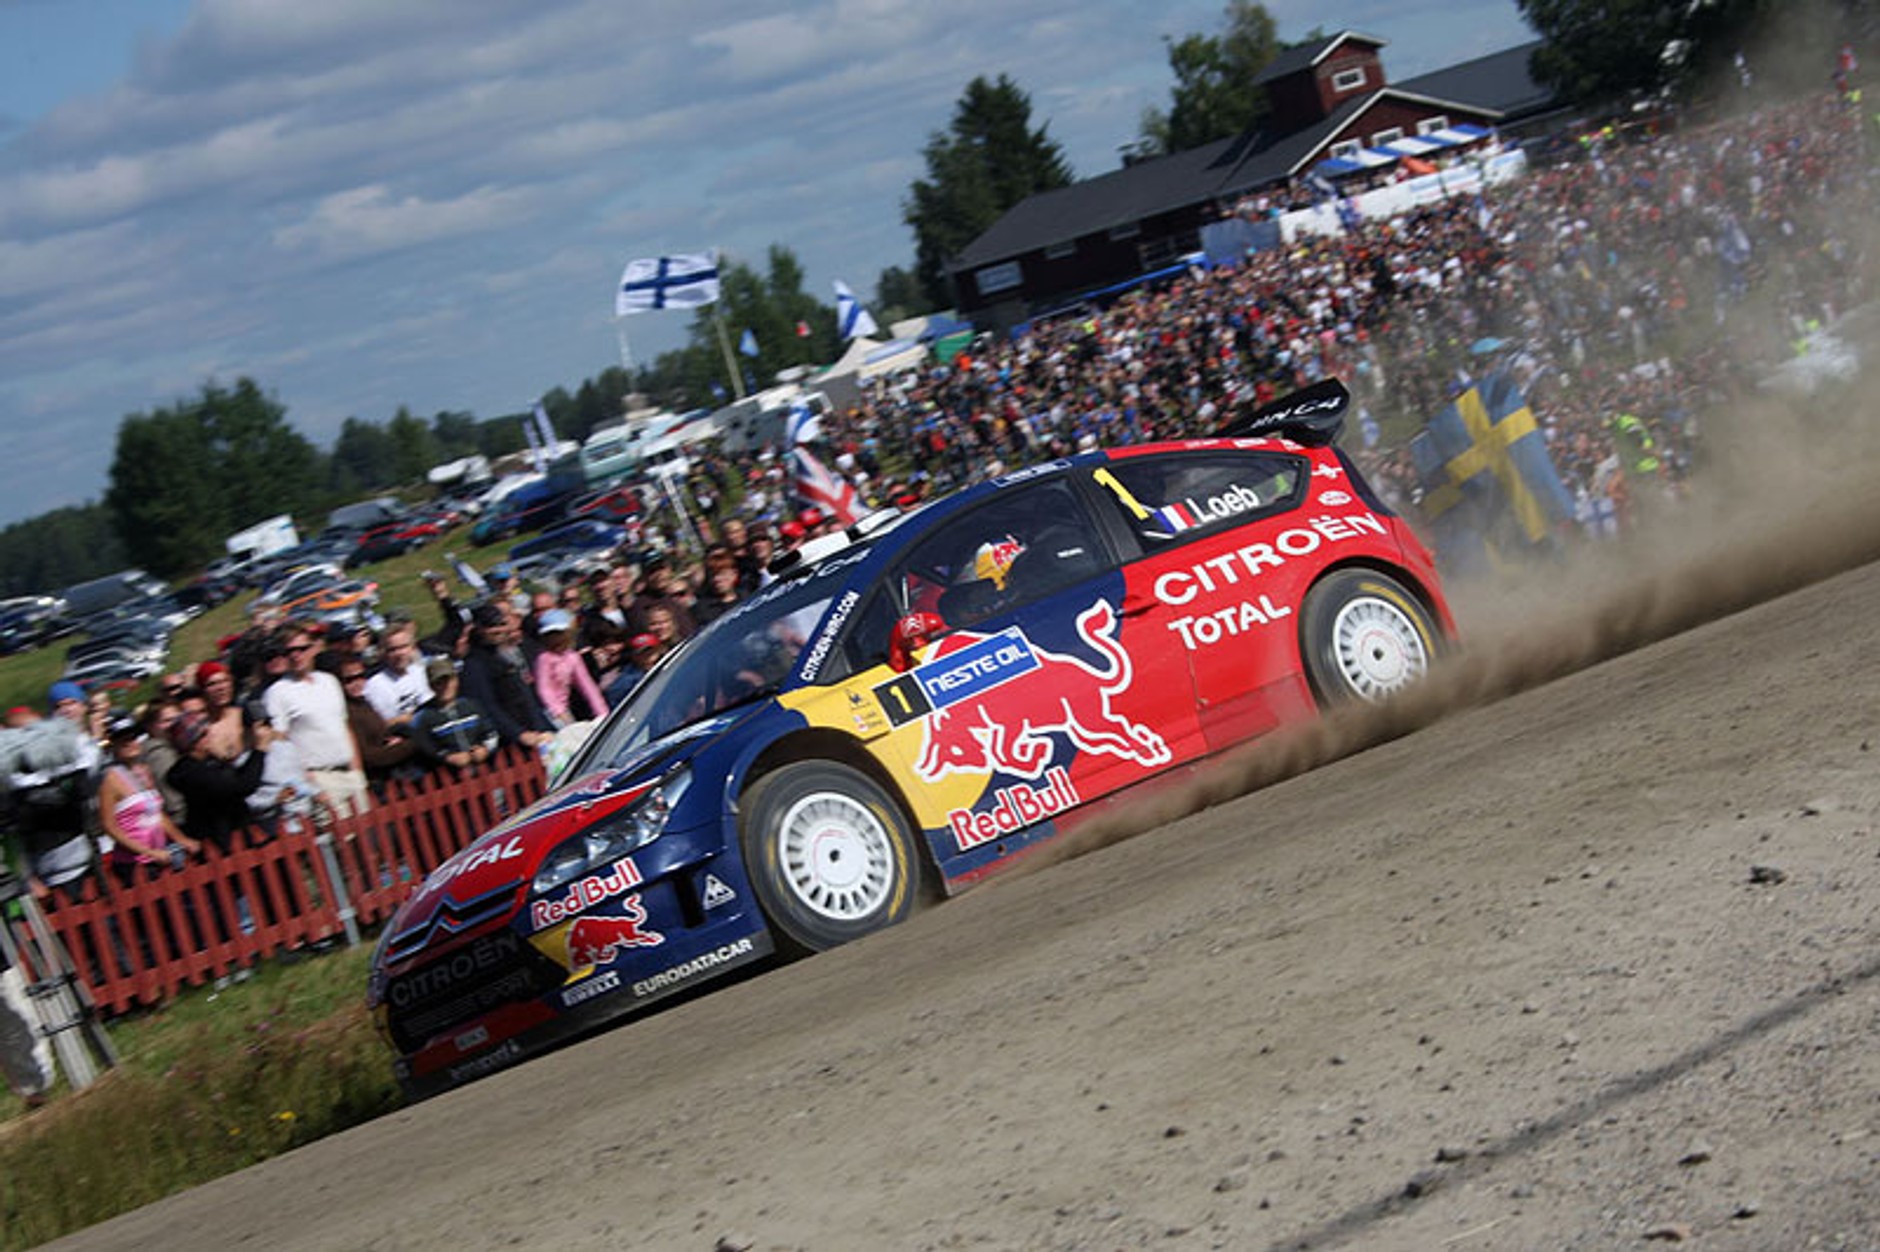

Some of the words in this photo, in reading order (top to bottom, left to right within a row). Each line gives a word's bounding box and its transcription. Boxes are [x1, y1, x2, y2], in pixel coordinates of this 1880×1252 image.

[1093, 467, 1150, 520] 1
[1185, 484, 1261, 524] Loeb
[1153, 511, 1388, 605] CITROËN
[1167, 594, 1292, 650] TOTAL
[926, 660, 995, 697] NESTE
[997, 640, 1029, 672] OIL
[889, 685, 913, 714] 1
[948, 793, 1018, 850] Red
[1005, 767, 1080, 826] Bull
[531, 879, 583, 930] Red
[580, 859, 643, 903] Bull
[632, 938, 753, 998] EURODATACAR
